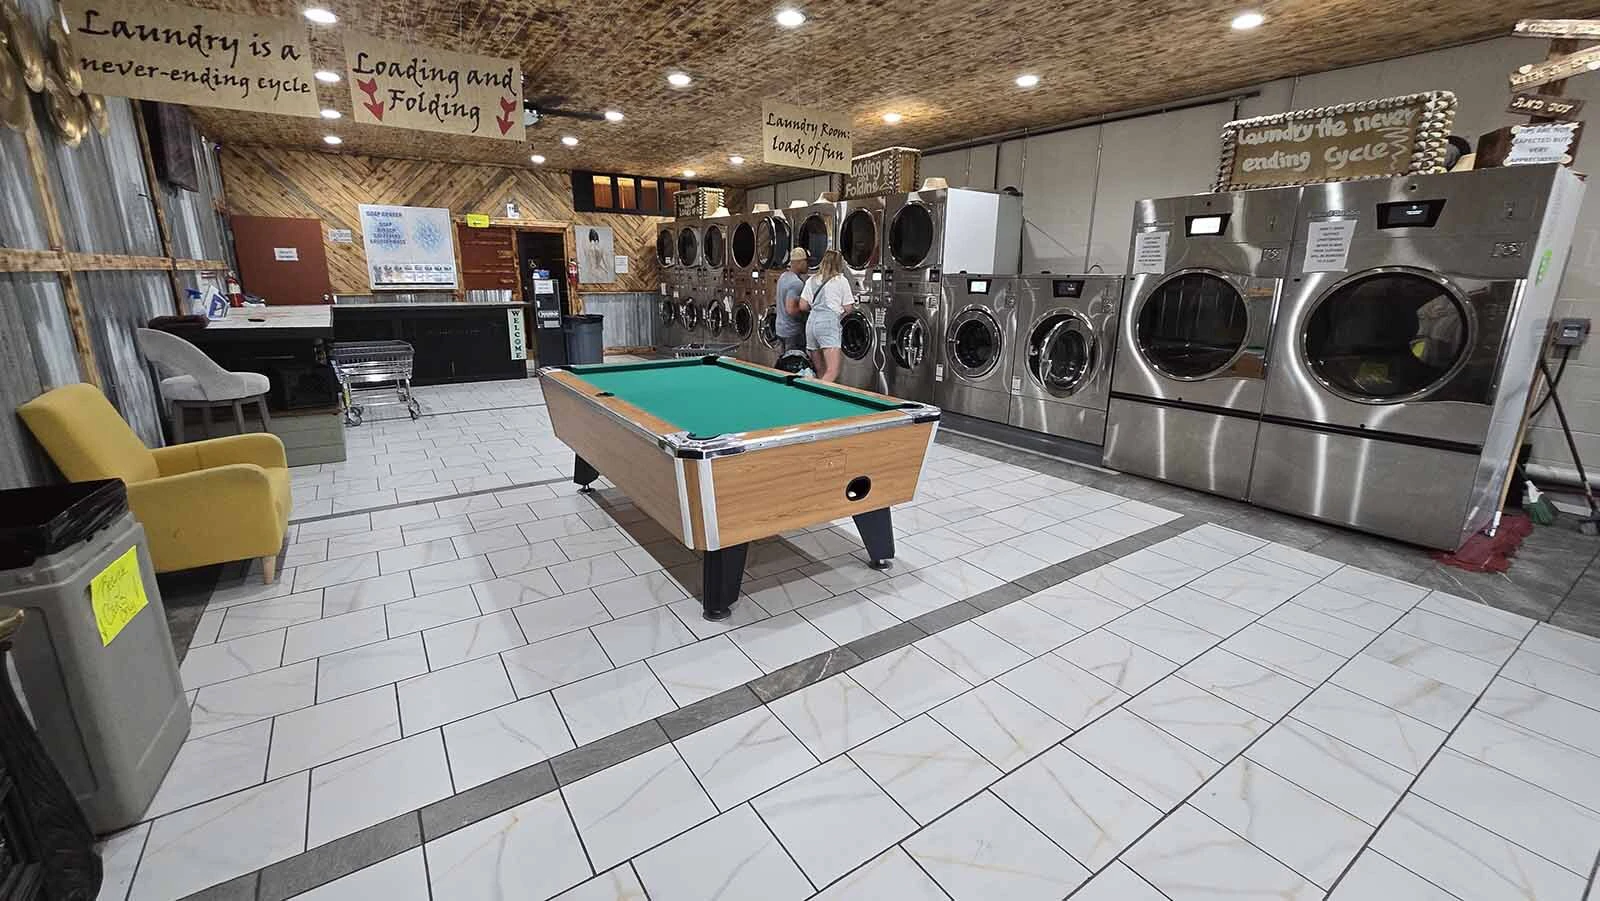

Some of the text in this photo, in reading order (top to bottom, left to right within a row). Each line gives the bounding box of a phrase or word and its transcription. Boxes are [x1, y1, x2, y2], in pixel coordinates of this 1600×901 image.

[77, 9, 301, 67] Laundry is a
[80, 56, 310, 100] never-ending cycle
[352, 52, 517, 98] Loading and
[388, 88, 481, 133] Folding
[1352, 107, 1417, 130] never
[1512, 97, 1574, 114] AND JOY
[766, 113, 850, 141] Laundry Room:
[772, 135, 845, 167] loads of fun
[1242, 150, 1311, 172] ending
[511, 310, 522, 359] WELCOME
